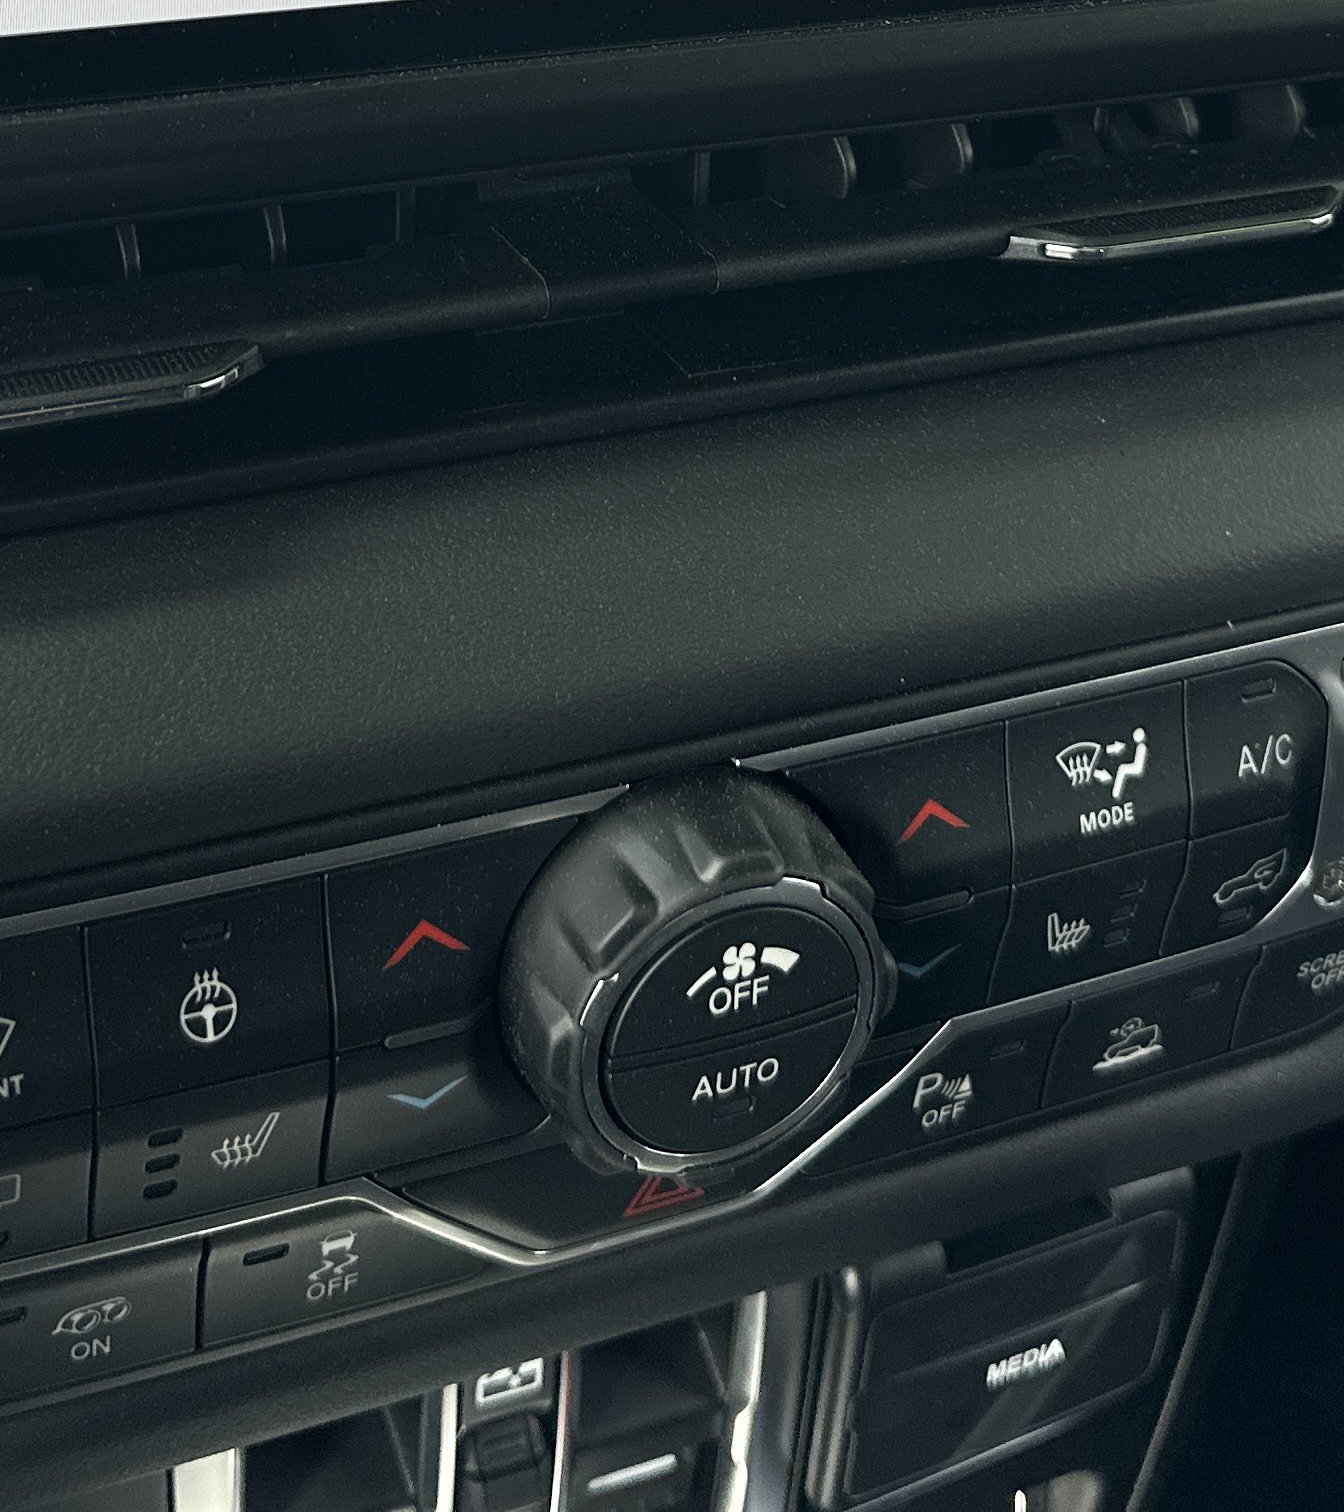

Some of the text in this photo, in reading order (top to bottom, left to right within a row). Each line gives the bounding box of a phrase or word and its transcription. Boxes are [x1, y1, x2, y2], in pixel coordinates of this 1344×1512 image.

[1238, 733, 1294, 780] A/C
[1080, 802, 1135, 834] MODE
[708, 976, 770, 1016] OFF
[691, 1057, 780, 1102] AUTO
[921, 1098, 965, 1129] OFF
[305, 1273, 360, 1301] OFF
[70, 1334, 112, 1360] ON
[986, 1338, 1066, 1390] MEDIA
